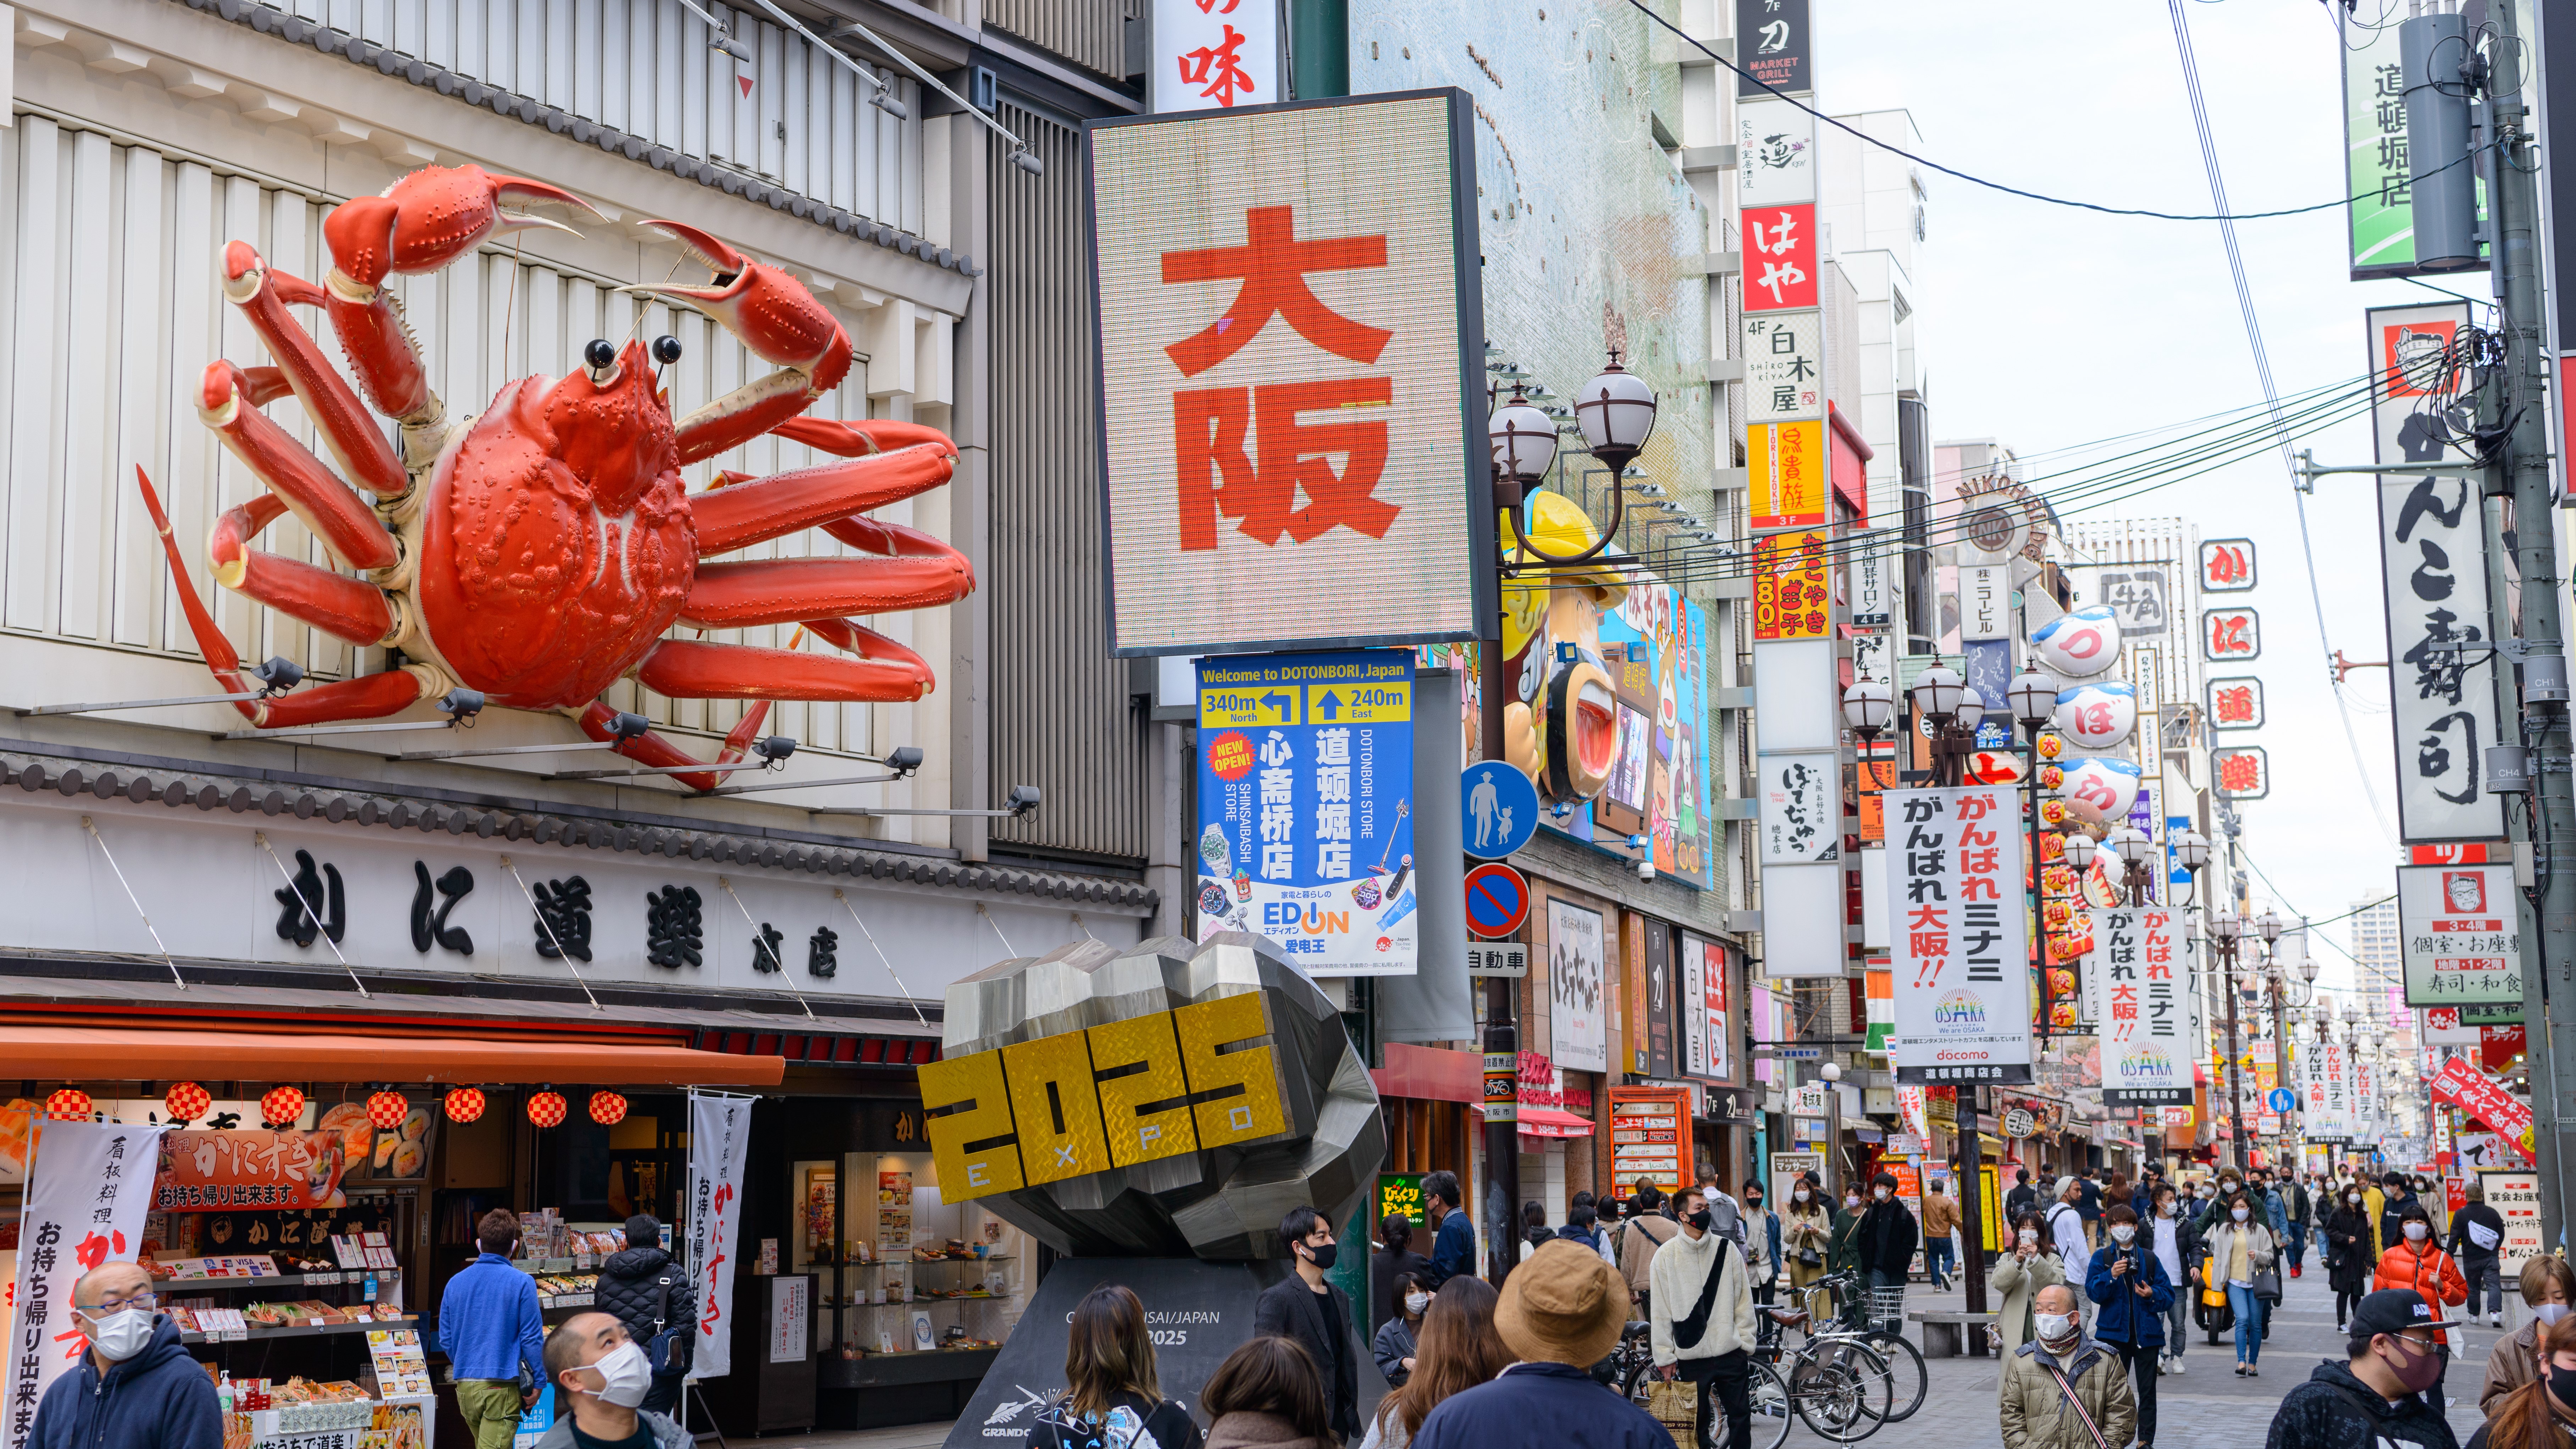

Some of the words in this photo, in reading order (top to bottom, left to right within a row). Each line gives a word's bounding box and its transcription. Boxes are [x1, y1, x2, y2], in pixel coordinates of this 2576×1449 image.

[1178, 0, 1255, 107] 味
[1750, 57, 1798, 70] MARKET
[1757, 68, 1792, 80] GRILL
[1741, 120, 1754, 189] 完全個室居酒屋
[1752, 211, 1806, 303] はや
[1748, 321, 1765, 335] 4F
[1771, 324, 1815, 412] 白木屋
[1162, 205, 1402, 551] 大阪
[1770, 428, 1779, 506] TORIKIZOKU
[1779, 516, 1796, 525] 3F
[1861, 532, 1878, 613] 浪花囲碁サロン
[1802, 533, 1827, 634] たこやき
[1780, 580, 1804, 635] 王子
[1861, 615, 1882, 624] 4F
[1203, 669, 1260, 683] Welcome
[1265, 668, 1278, 680] to
[1282, 664, 1364, 680] DOTONBORI,
[1366, 663, 1404, 678] Japan
[1623, 657, 1646, 697] 道頓堀
[2535, 678, 2554, 687] CH1
[1206, 694, 1256, 712] 340m
[1351, 689, 1403, 707] 240m
[1231, 713, 1257, 722] North
[1352, 709, 1372, 718] East
[1216, 739, 1244, 757] NEW
[1215, 754, 1251, 773] OPEN!
[1360, 729, 1372, 797] DOTONBORI
[2498, 769, 2520, 778] CH4
[1225, 784, 1237, 822] STORE
[1782, 763, 1818, 853] ぼてぢゅう
[1816, 794, 1824, 824] お好み焼
[1239, 783, 1251, 863] SHINSAIBASHI
[1361, 801, 1373, 839] STORE
[1824, 851, 1837, 860] 2F
[1281, 890, 1331, 899] 家電と暮らしの
[1956, 793, 2003, 982] がんばれミナミ
[1264, 902, 1349, 935] EDION
[2449, 920, 2486, 931] 3・4階
[1264, 927, 1299, 935] エディオン
[1653, 931, 1660, 950] 7F
[1468, 951, 1524, 969] 自動車
[2437, 959, 2503, 970] 地階・1・2階
[2143, 912, 2175, 1036] がんばれミナミ
[2427, 973, 2522, 993] 寿司・和食
[1690, 958, 1703, 1068] 白木屋
[1936, 997, 1985, 1023] OSAKA
[1652, 1021, 1667, 1038] MARKET
[2483, 1028, 2523, 1042] ドラッグ
[1655, 1036, 1666, 1052] GRILL
[1901, 1035, 2024, 1045] 道頓堀エンタメストリートカフェを応援しています。
[1598, 1045, 1604, 1060] 2F
[1638, 1051, 1645, 1069] 3F
[1937, 1049, 1989, 1061] docomo
[2121, 1049, 2172, 1076] OSAKA
[1925, 1066, 2003, 1080] 道頓堀商店会
[2326, 1046, 2344, 1110] がんばれミナミ
[917, 990, 1291, 1205] 2025
[2118, 1090, 2179, 1100] 道頓堀商店会
[2357, 1065, 2373, 1121] がんばれミナミ
[2449, 1066, 2532, 1128] しゃぶしゃぶ
[1486, 1108, 1510, 1117] 大阪市
[1707, 1095, 1717, 1113] 7F
[2166, 1112, 2182, 1122] 2F
[2460, 1090, 2526, 1142] 食べ放題
[720, 1108, 735, 1179] 看板料理
[192, 1133, 314, 1182] かにすき
[1776, 1162, 1817, 1171] マッサージ
[93, 1135, 127, 1224] 看板料理
[1884, 1166, 1918, 1176] タイ料理
[158, 1183, 298, 1207] お持ち帰り出来ます。
[1384, 1187, 1419, 1202] びっくり
[1382, 1201, 1422, 1217] ドンキー
[701, 1182, 733, 1335] かにすき
